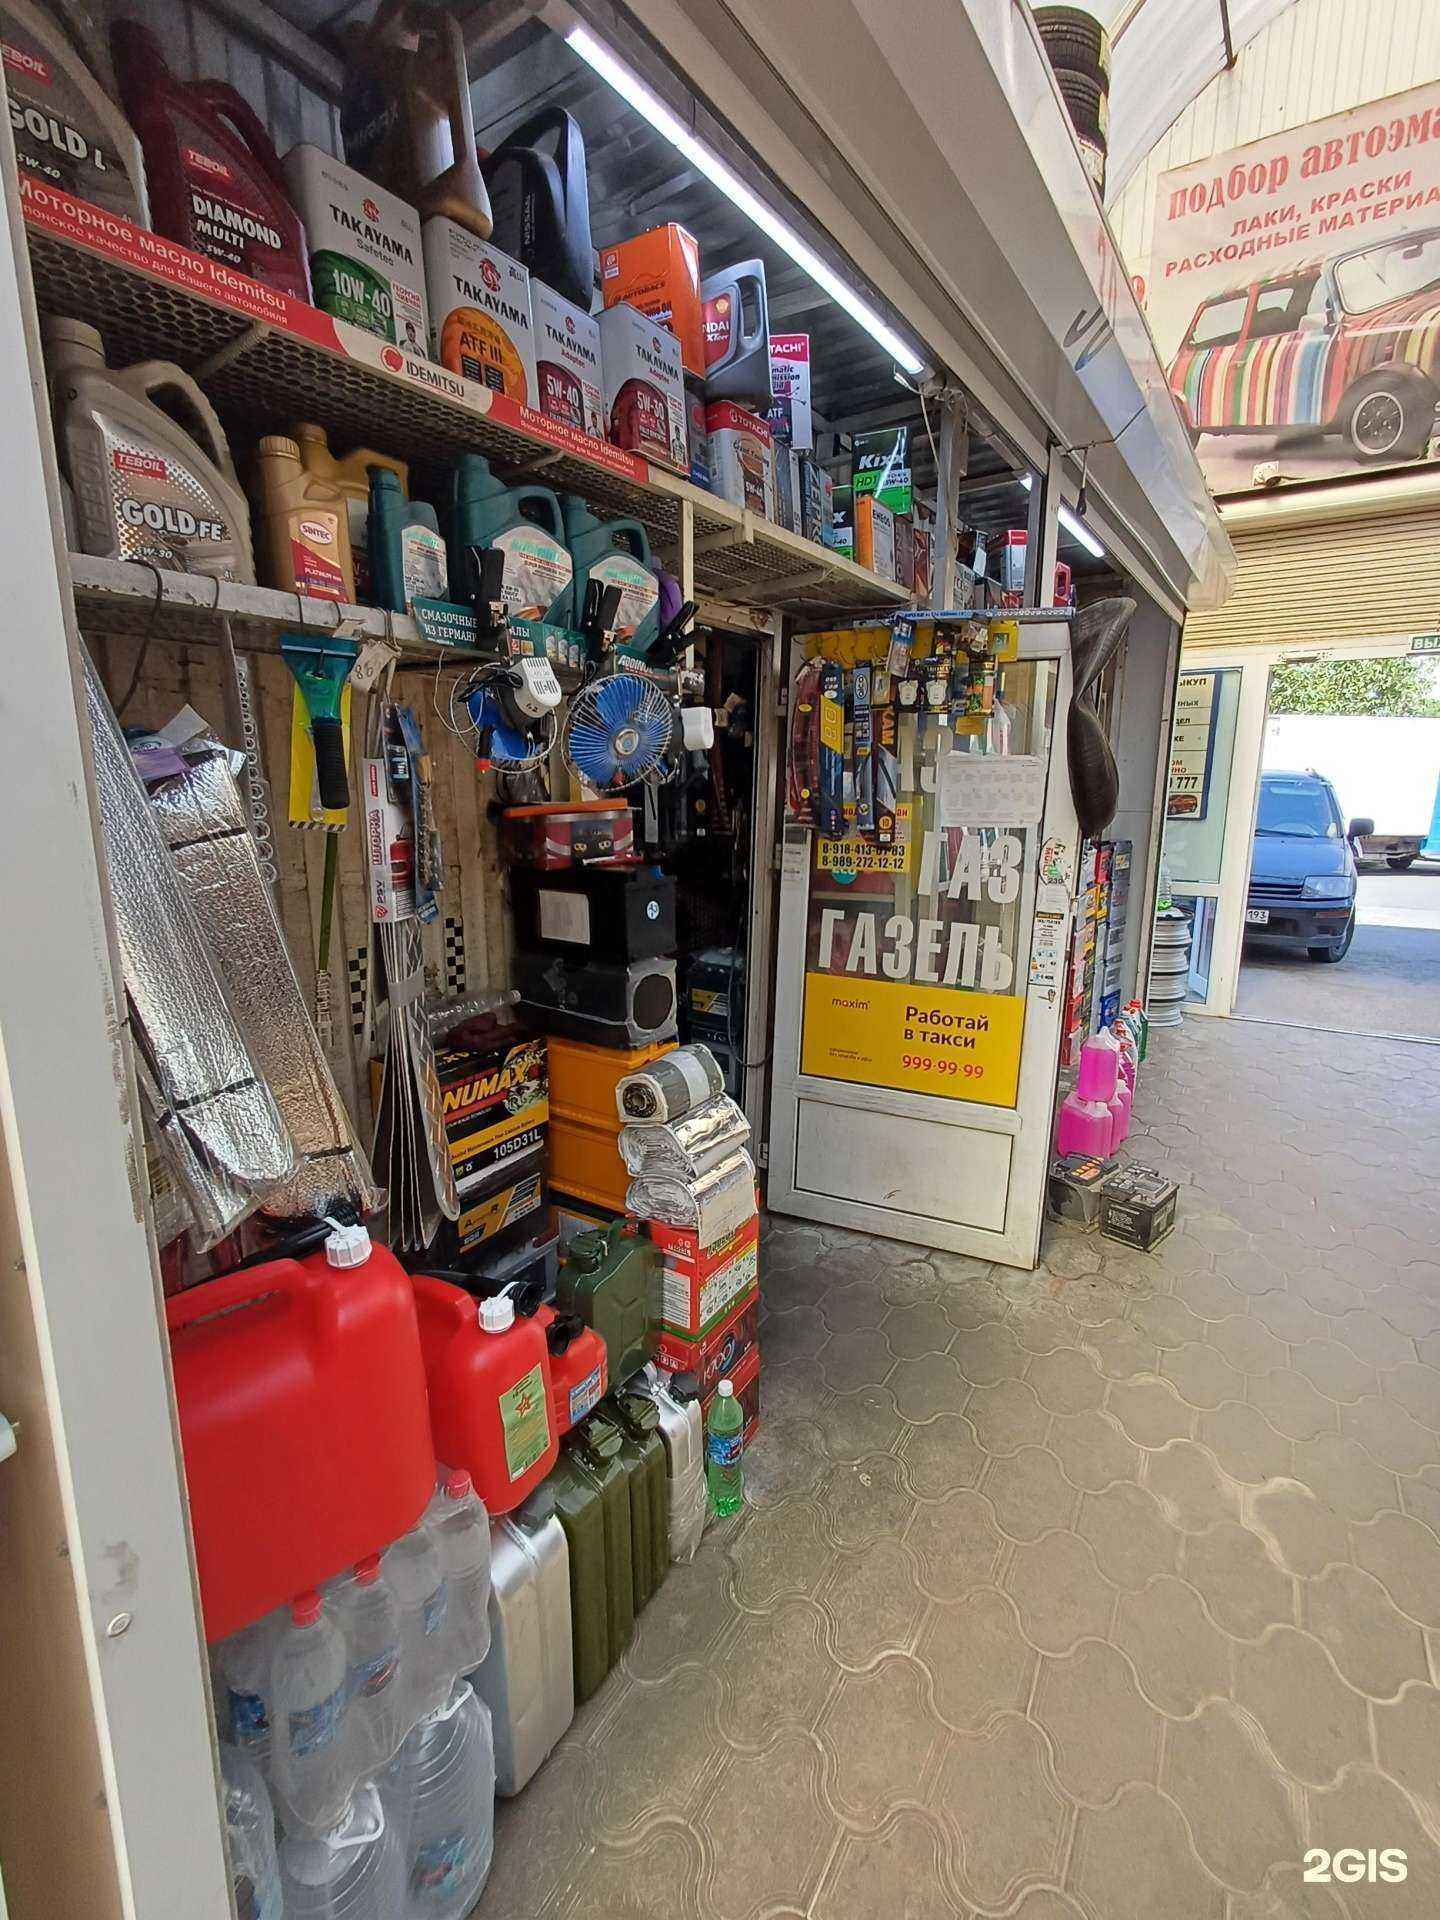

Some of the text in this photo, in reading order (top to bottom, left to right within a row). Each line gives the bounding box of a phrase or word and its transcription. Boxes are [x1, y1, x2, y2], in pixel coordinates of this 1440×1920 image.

[1, 44, 47, 77] EBOIL
[9, 98, 88, 159] GOLD
[1167, 154, 1290, 221] подбор
[1230, 169, 1413, 237] ЛАКИ, КРАСКИ
[192, 193, 282, 250] DIAMOND
[196, 219, 245, 249] MULTI
[329, 204, 413, 265] TAKAYAMA
[1165, 185, 1440, 277] РАСХОДНЫЕ МАТЕРИА
[24, 204, 85, 237] понское
[223, 291, 289, 325] автомобиля
[139, 235, 205, 275] масло
[209, 264, 286, 311] Idemitsu
[333, 268, 392, 318] 10W-40
[453, 274, 529, 330] TAKAYAMA
[459, 331, 488, 354] ATF
[545, 323, 597, 366] TAKAYAMA
[405, 360, 465, 398] IDEMITSU
[635, 343, 680, 381] TAKAYAMA
[546, 373, 579, 408] 5W-40
[636, 390, 665, 420] 5W-30
[767, 408, 784, 418] ATF
[117, 453, 164, 473] TEBOIL
[120, 497, 198, 536] GOLD
[198, 520, 223, 542] FE
[302, 525, 331, 541] SINTEC
[134, 546, 173, 560] 5W-30
[421, 608, 479, 628] СМАЗОЧНЫЕ
[372, 808, 382, 866] ШТОРКА
[917, 829, 1025, 904] ГАЗ
[375, 879, 384, 904] PSV
[818, 908, 1014, 993] ГАЗЕЛЬ
[831, 998, 869, 1010] maxim
[904, 1005, 990, 1032] Работай
[903, 1028, 976, 1050] в такси
[901, 1054, 985, 1079] 999-99-99
[443, 1062, 530, 1114] NUMAX
[493, 1133, 542, 1160] 105D31L
